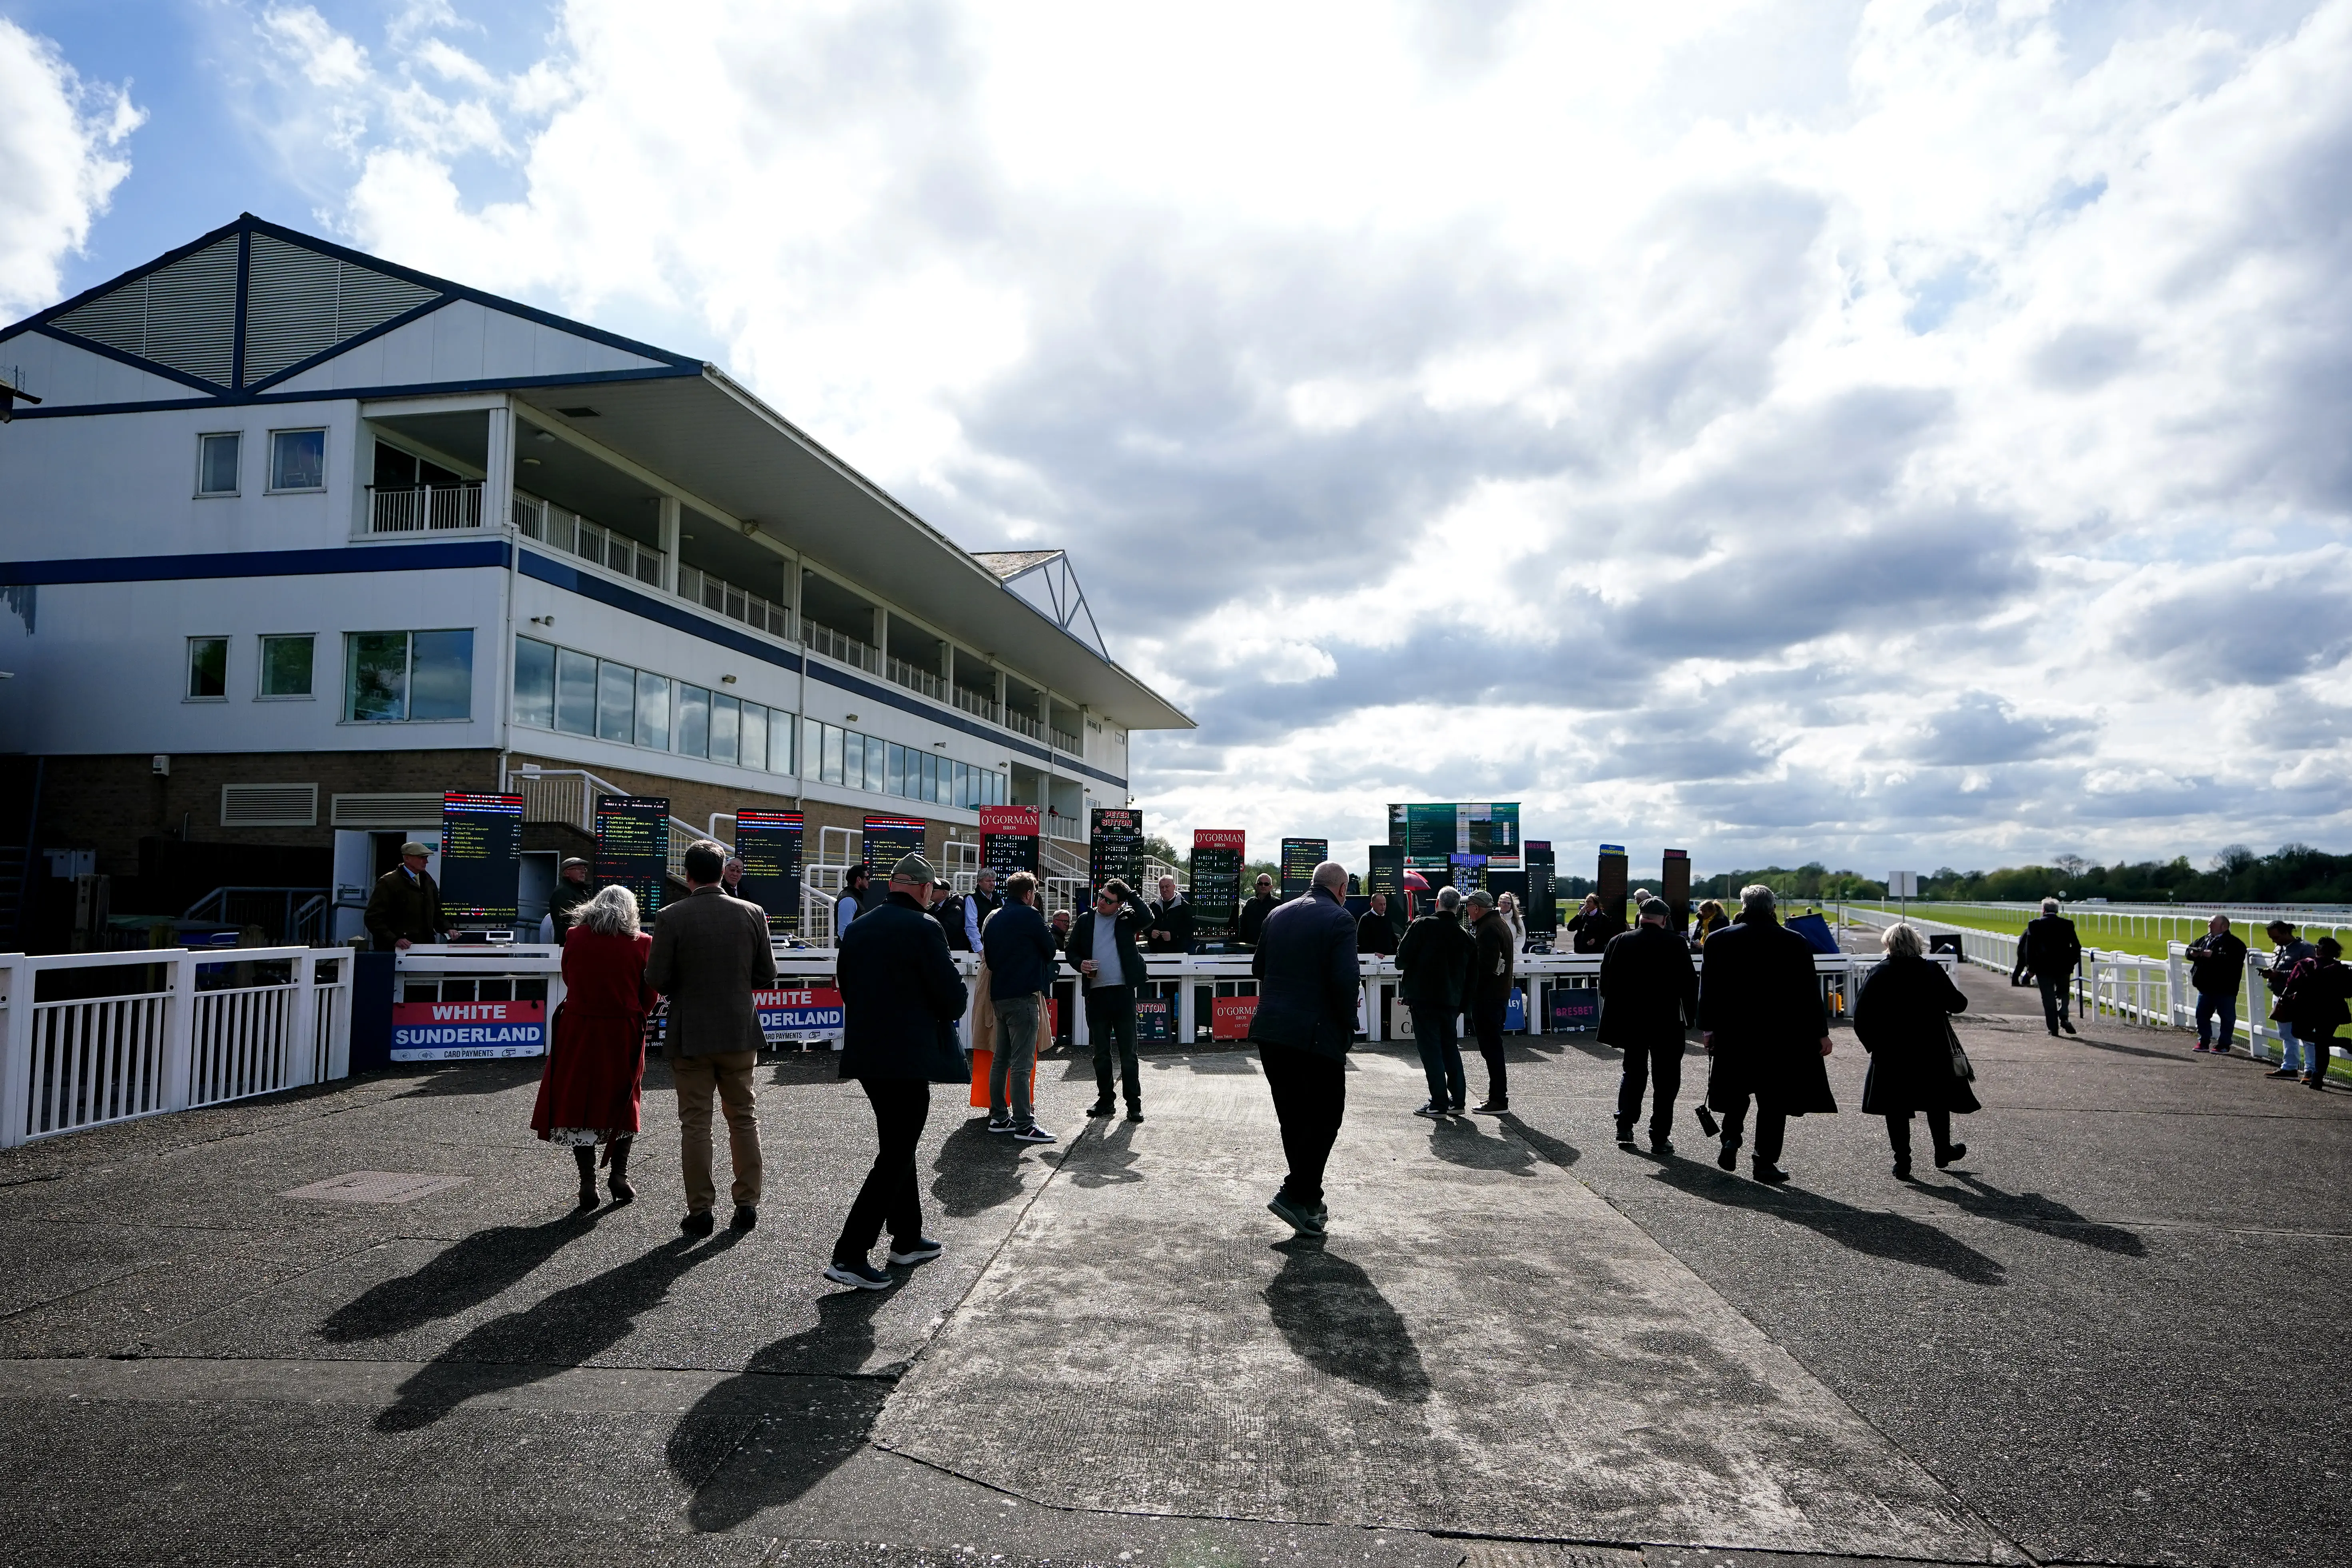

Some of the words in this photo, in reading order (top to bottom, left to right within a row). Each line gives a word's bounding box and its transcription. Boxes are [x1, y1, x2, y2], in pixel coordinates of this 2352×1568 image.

[1105, 810, 1130, 819] PETER
[981, 815, 1037, 825] O'GORMAN
[1196, 833, 1244, 843] O'GORMAN
[752, 991, 812, 1005] WHITE
[432, 1004, 506, 1020] WHITE
[1556, 1006, 1593, 1016] BRESBET
[395, 1027, 540, 1045] SUNDERLAND
